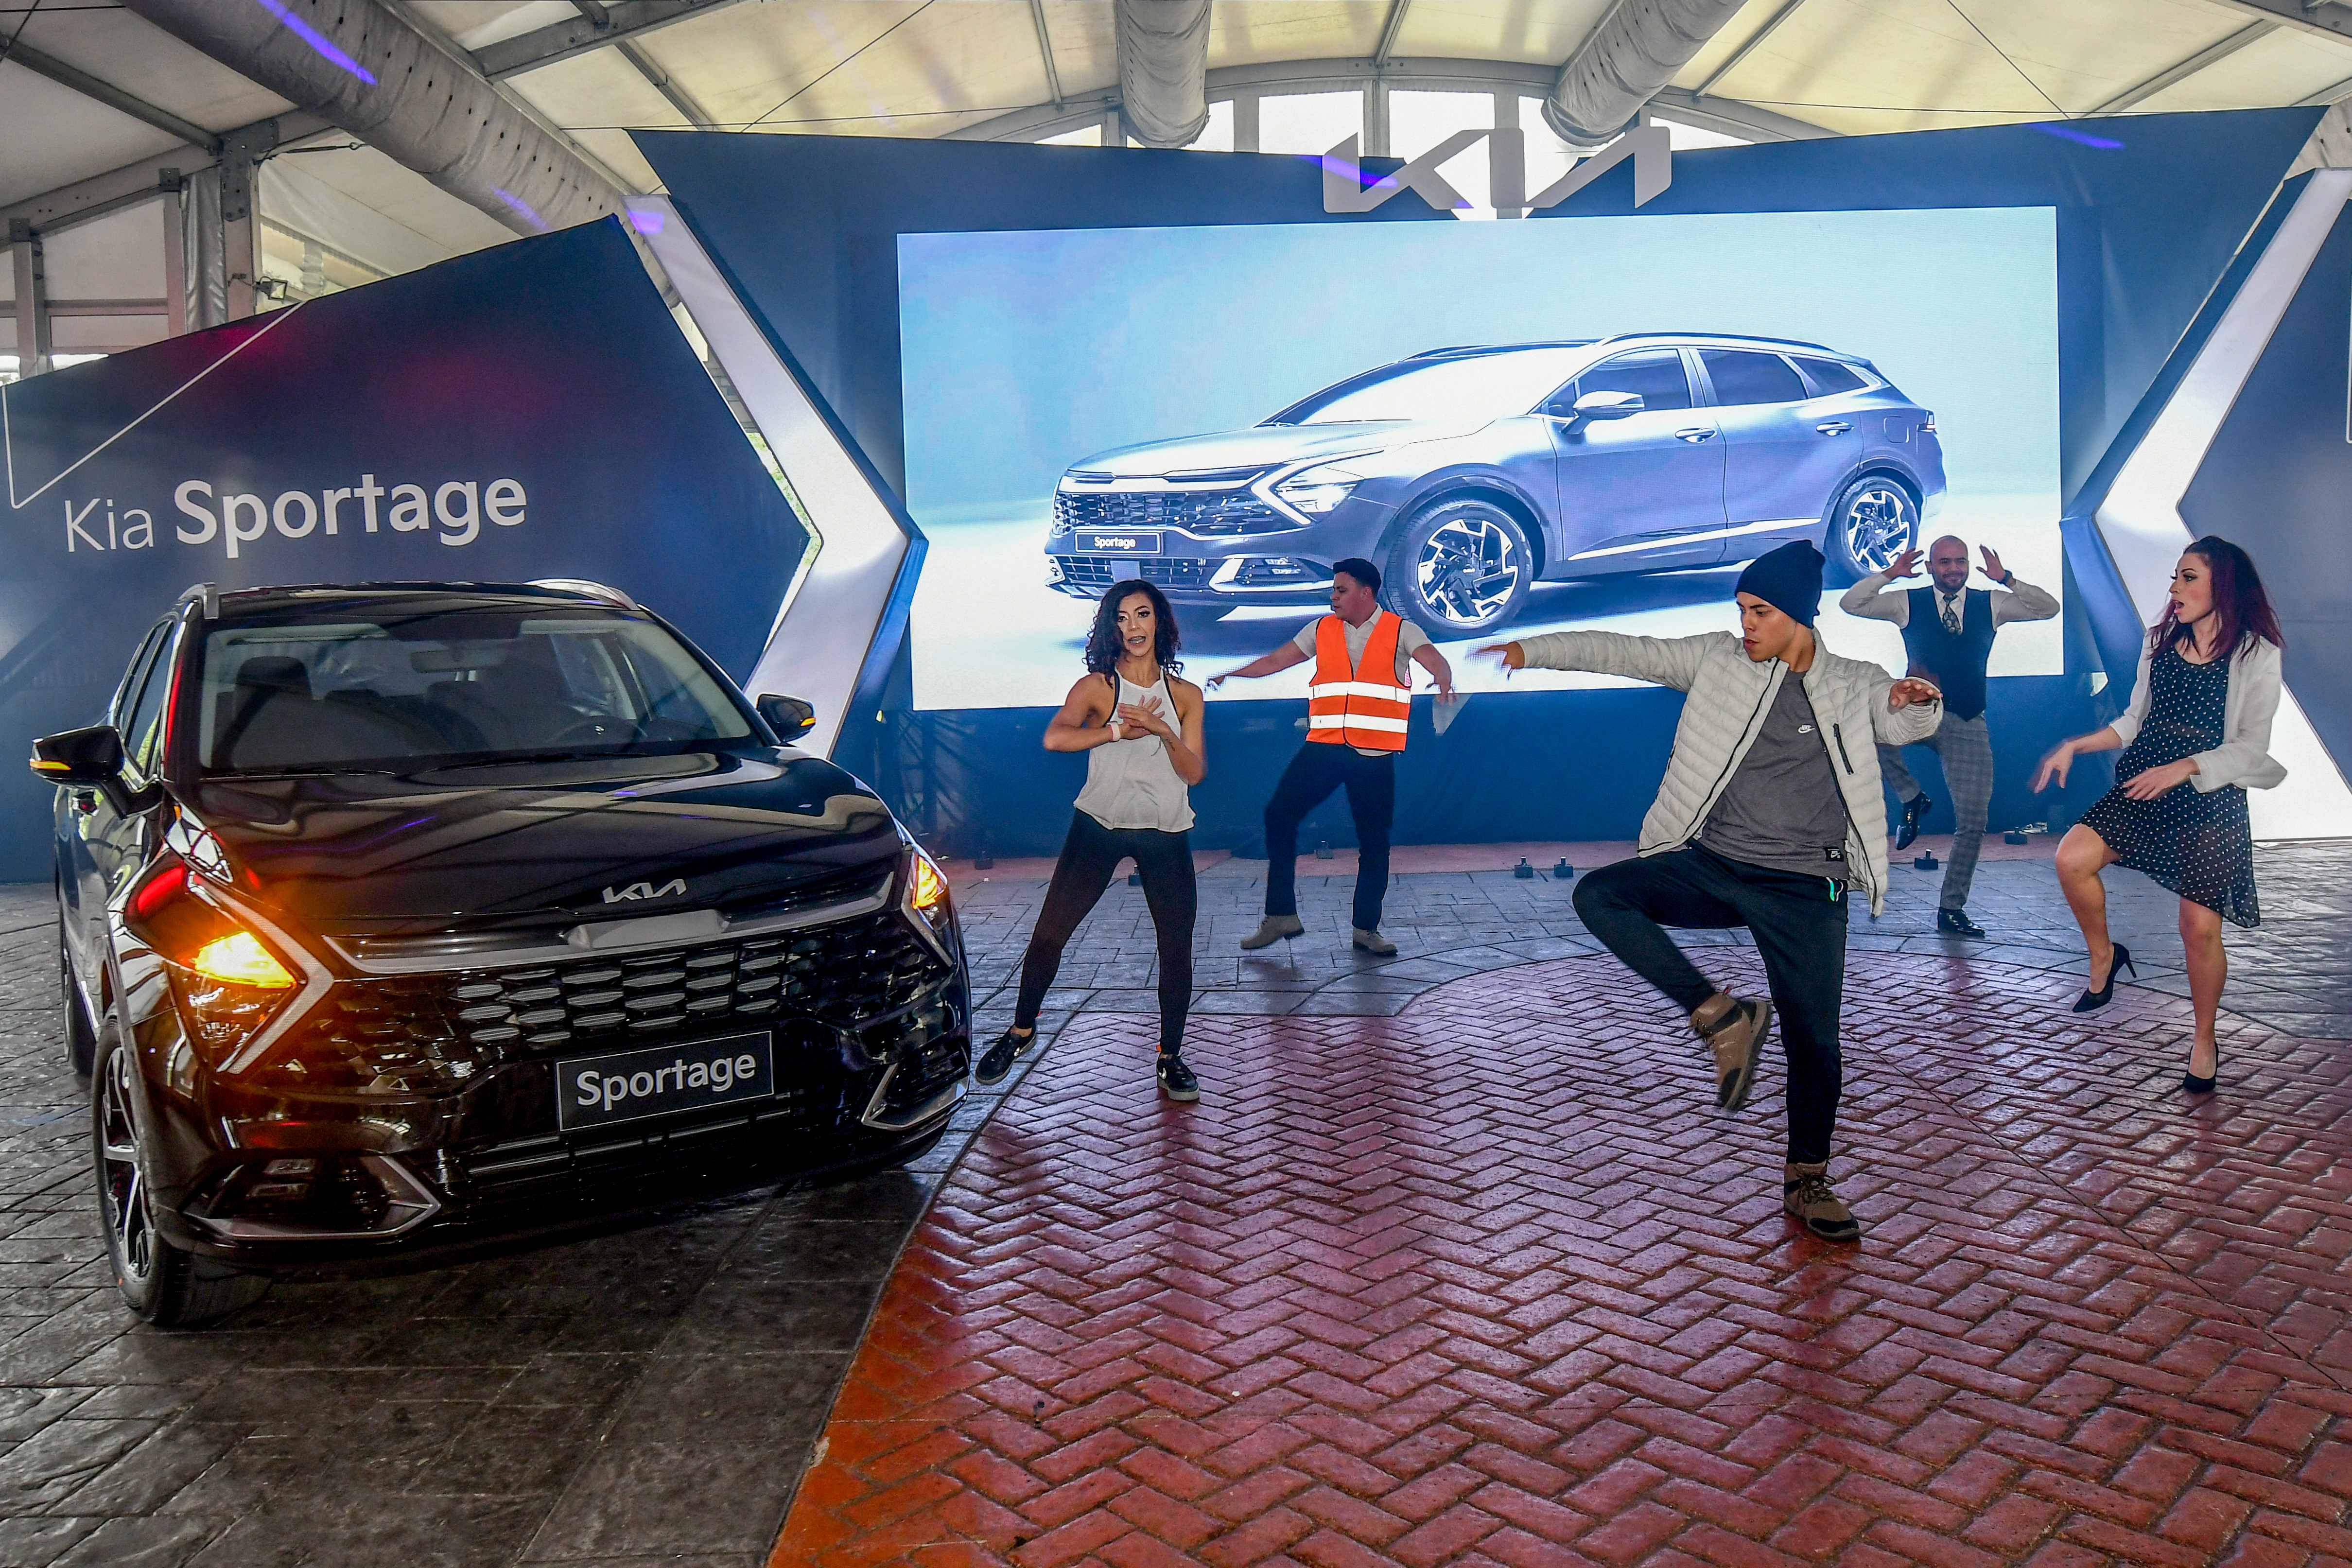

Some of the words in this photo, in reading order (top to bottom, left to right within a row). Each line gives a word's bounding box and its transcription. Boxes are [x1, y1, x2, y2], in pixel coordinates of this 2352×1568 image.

[1323, 126, 1672, 213] KIA
[65, 498, 154, 552] Kia
[174, 474, 527, 558] Sportage
[1094, 536, 1136, 549] Sportage
[602, 879, 687, 903] KIA
[576, 1054, 756, 1111] Sportage
